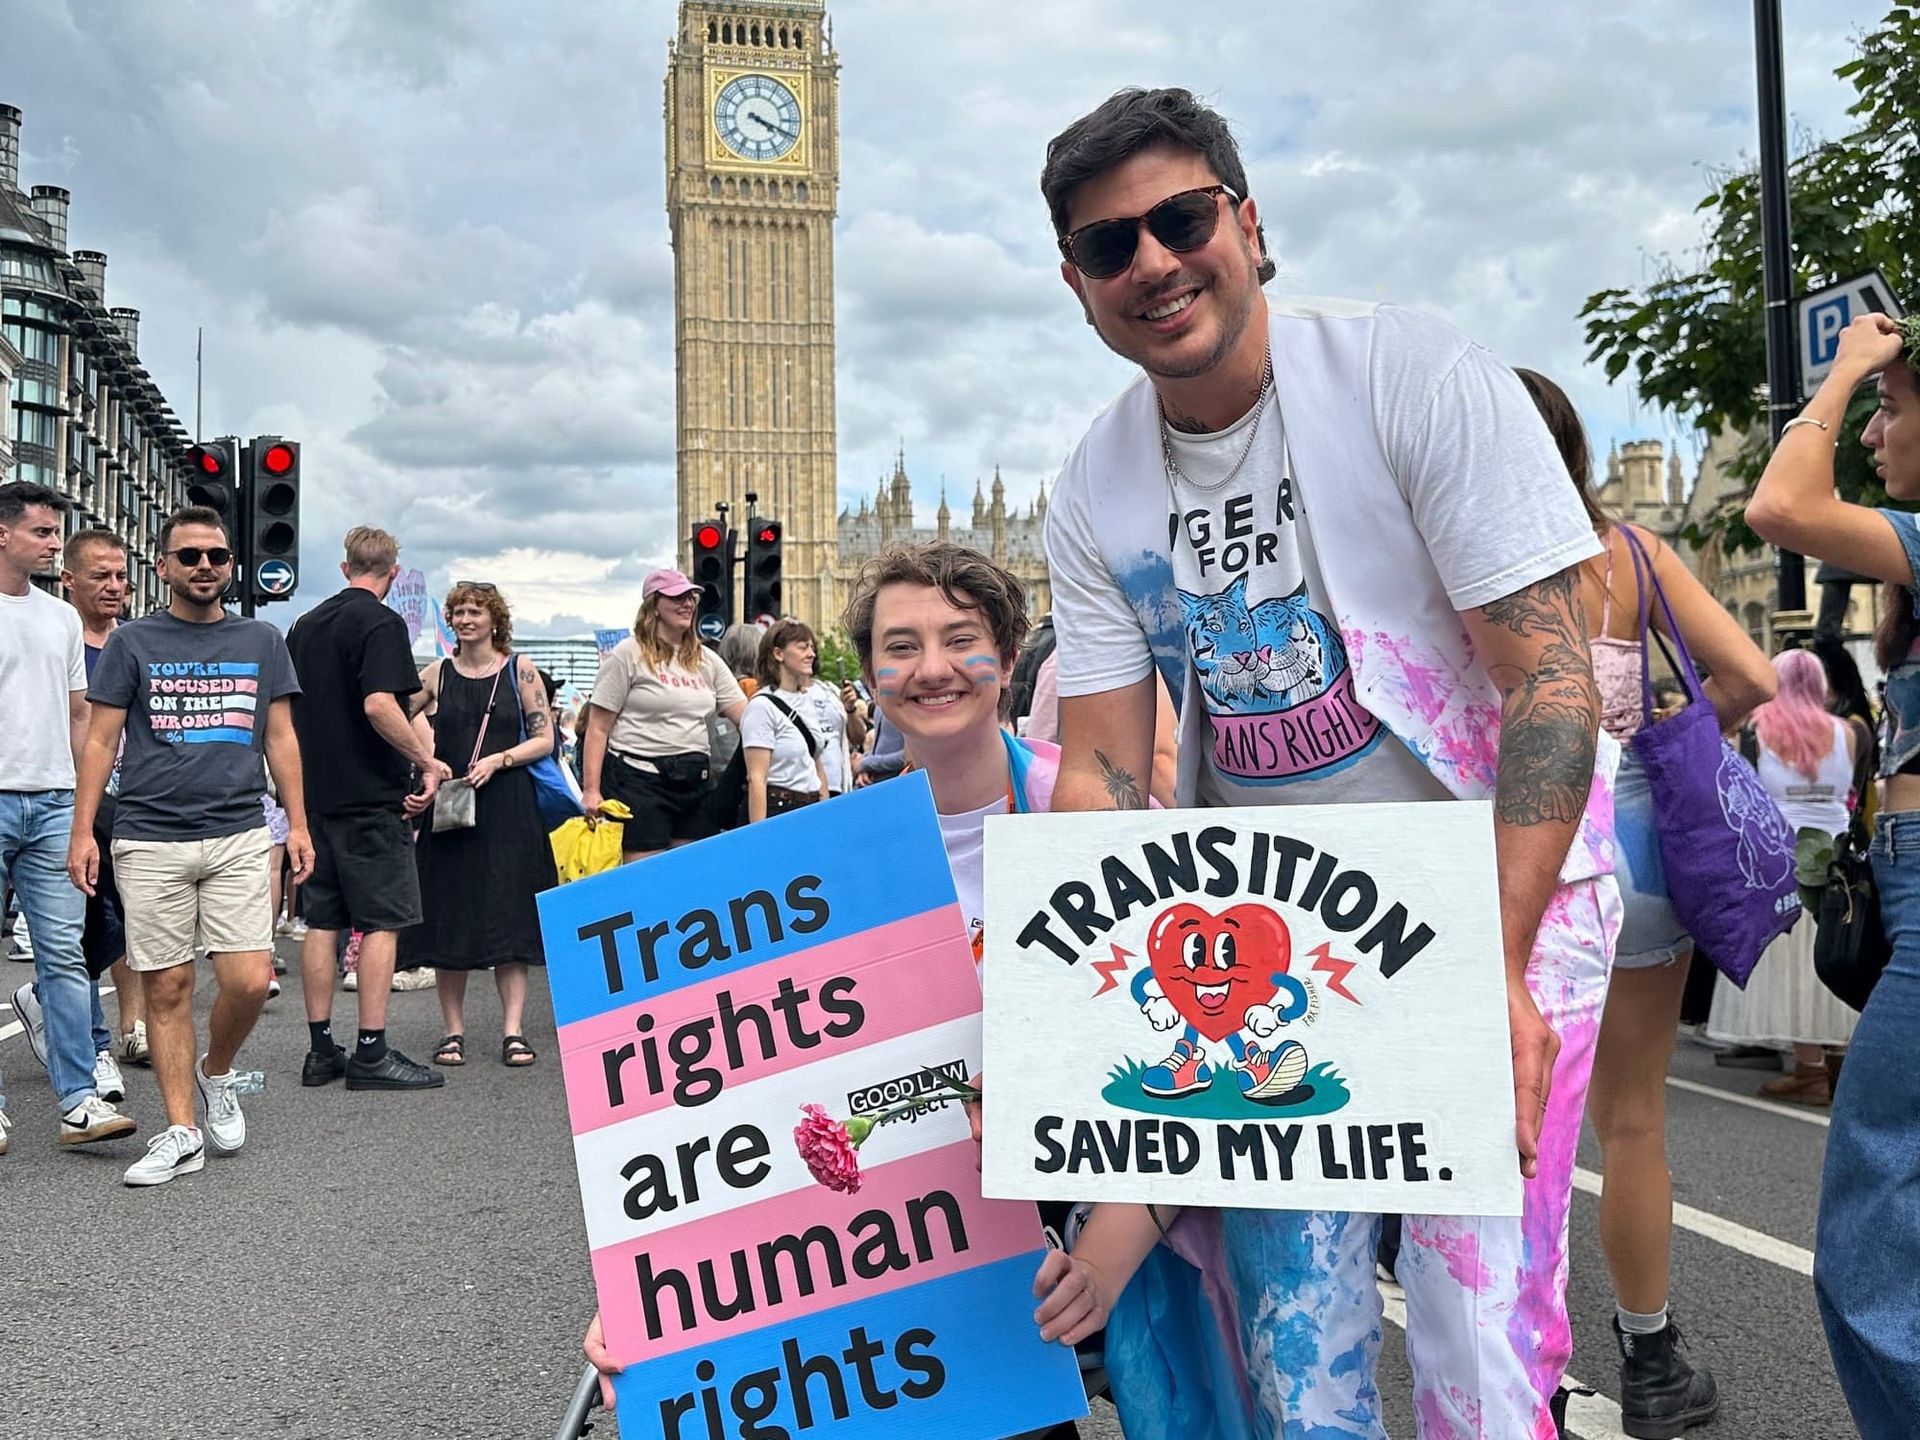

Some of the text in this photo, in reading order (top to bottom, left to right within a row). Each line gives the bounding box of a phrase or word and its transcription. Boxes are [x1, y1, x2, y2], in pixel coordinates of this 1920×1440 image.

[1816, 304, 1842, 359] P
[1168, 477, 1306, 552] IGER
[1199, 532, 1278, 577] FOR
[148, 662, 219, 676] YOU'RE
[149, 678, 235, 693] FOCUSED
[149, 695, 222, 711] ON THE
[149, 713, 223, 729] WRONG
[577, 874, 831, 995] Trans
[1016, 826, 1436, 979] TRANSITION
[601, 975, 866, 1108] rights
[850, 1078, 914, 1113] GOOD
[619, 1122, 771, 1221] are
[1034, 1115, 1453, 1182] SAVED MY LIFE.
[634, 1189, 970, 1341] human
[659, 1324, 947, 1440] rights
